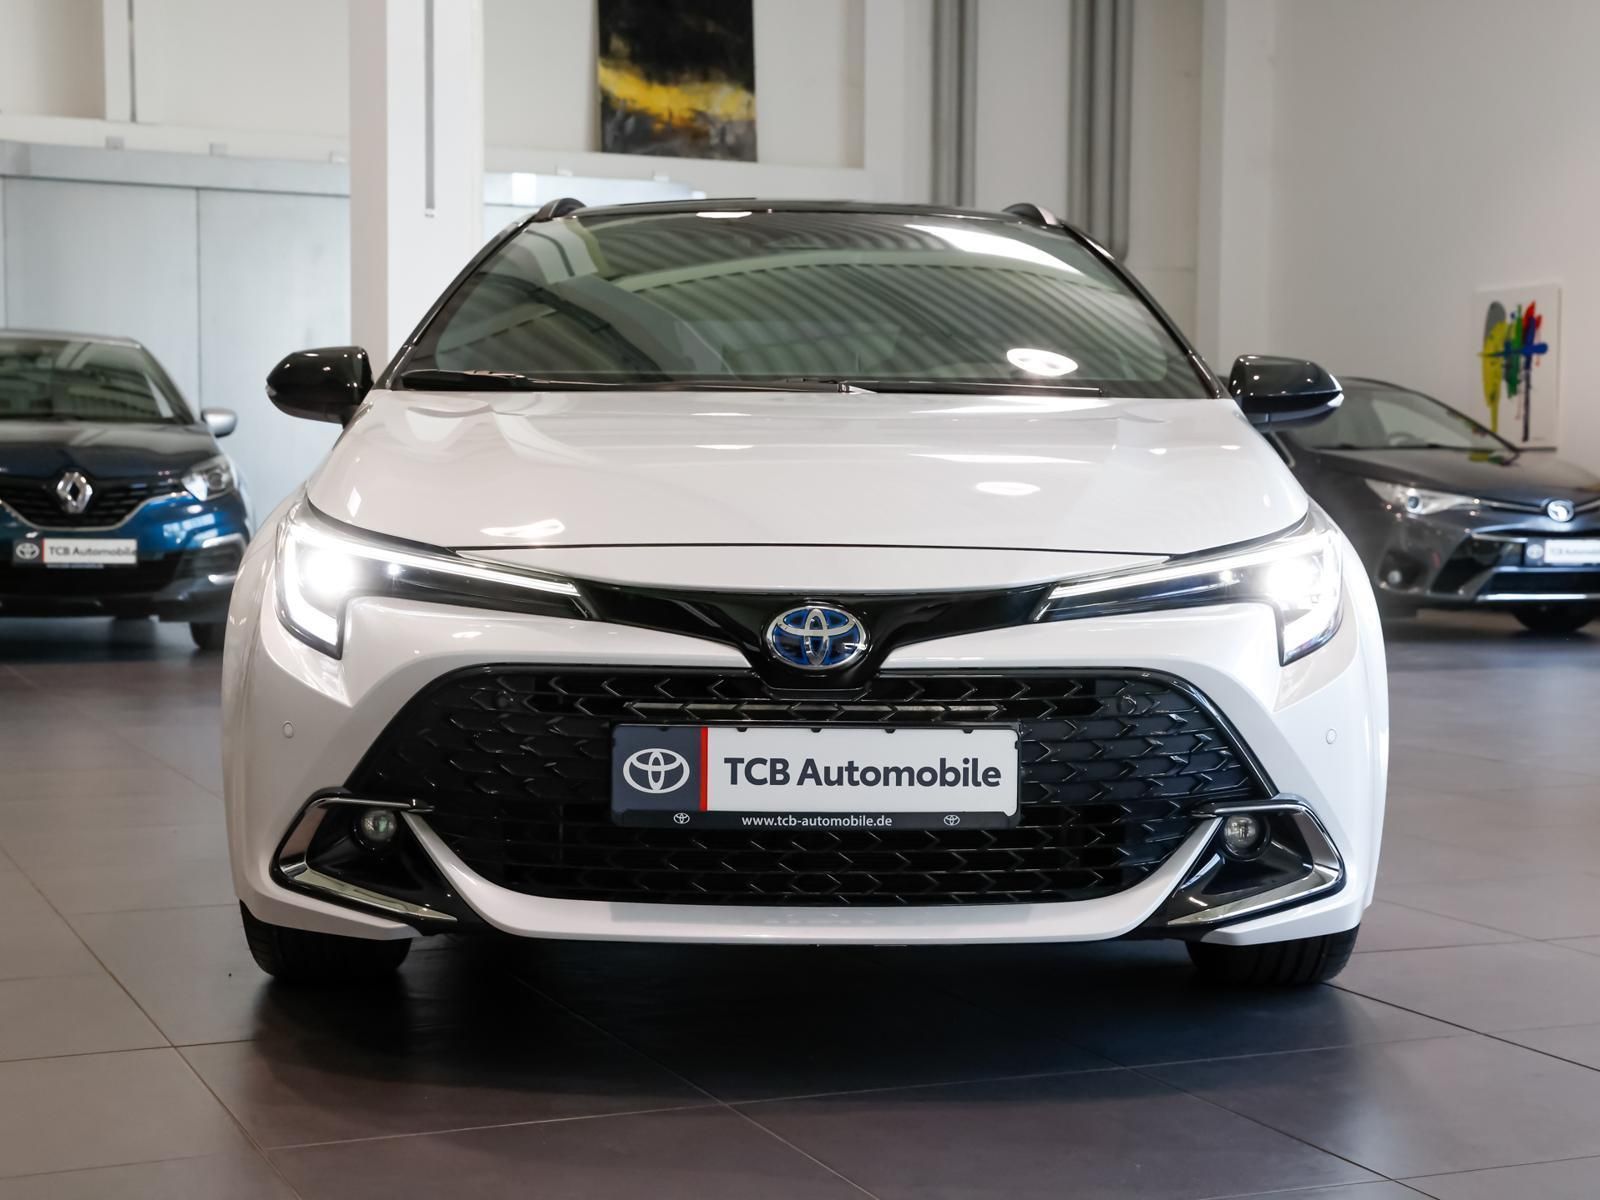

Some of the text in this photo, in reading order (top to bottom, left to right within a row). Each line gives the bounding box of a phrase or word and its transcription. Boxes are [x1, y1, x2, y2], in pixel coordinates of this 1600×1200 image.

[48, 546, 70, 556] TCB
[723, 757, 1002, 788] TCB Automobile
[741, 814, 893, 827] www.tcb-automobile.de
